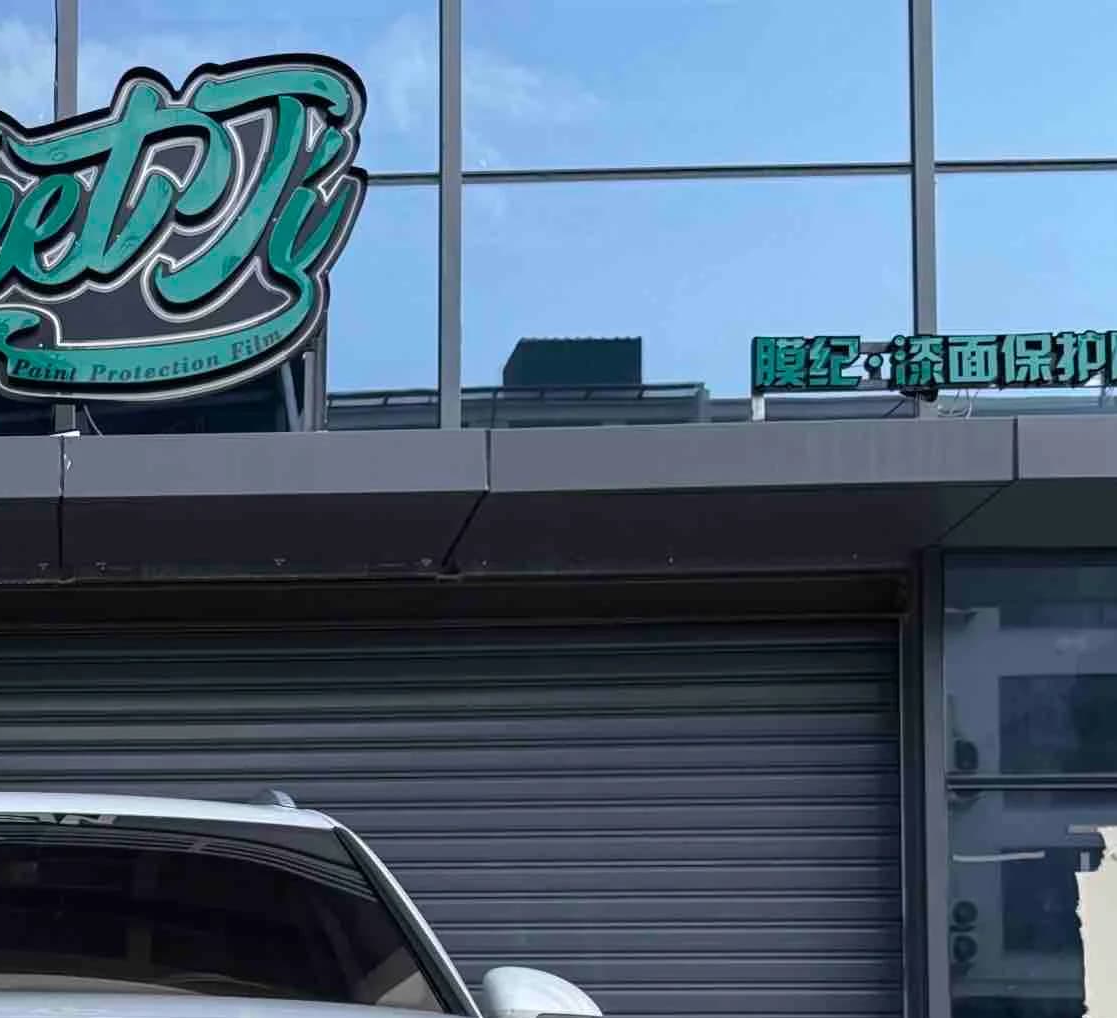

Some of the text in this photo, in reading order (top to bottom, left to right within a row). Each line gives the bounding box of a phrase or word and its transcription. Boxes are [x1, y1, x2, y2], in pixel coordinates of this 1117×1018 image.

[10, 328, 282, 382] Paint Protection Film
[754, 331, 1117, 388] 膜纪·漆面保护
